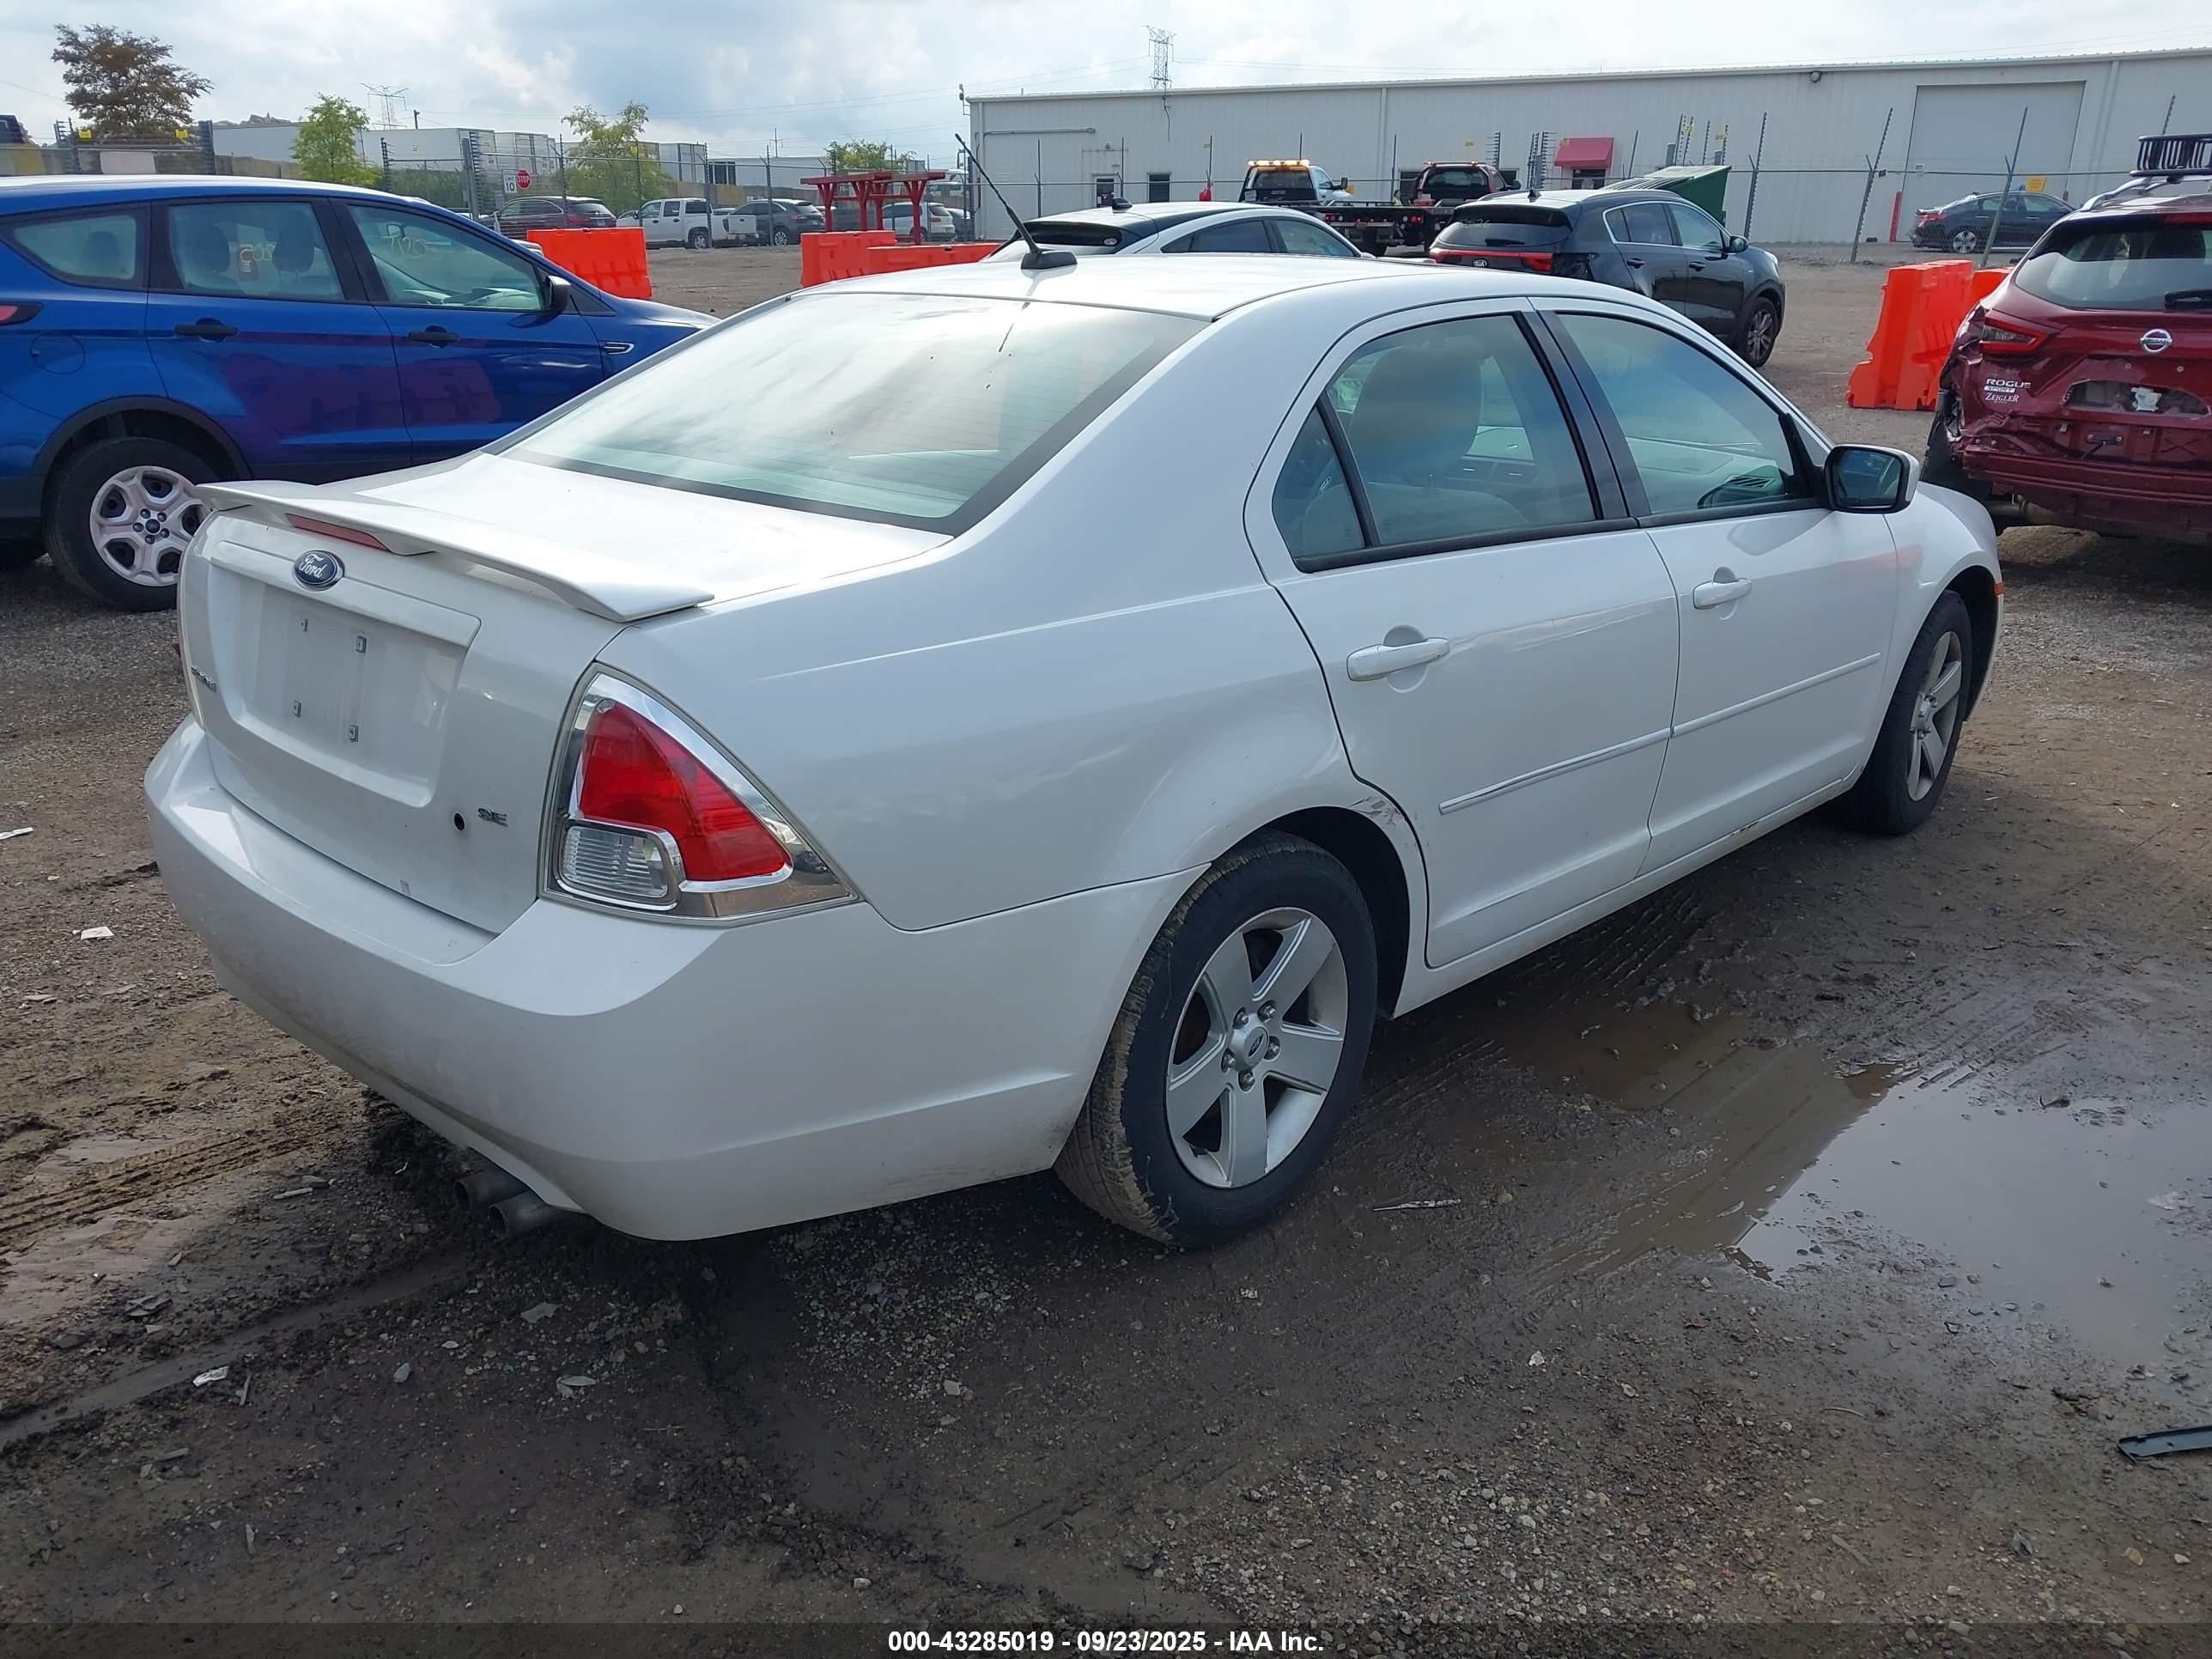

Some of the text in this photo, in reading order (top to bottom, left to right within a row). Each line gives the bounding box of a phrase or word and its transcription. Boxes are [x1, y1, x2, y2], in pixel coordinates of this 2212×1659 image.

[505, 182, 515, 191] 10
[1986, 379, 2031, 388] ROGUE
[1985, 392, 2019, 403] ZEIGLER
[299, 553, 327, 579] Ford
[477, 808, 508, 827] SE
